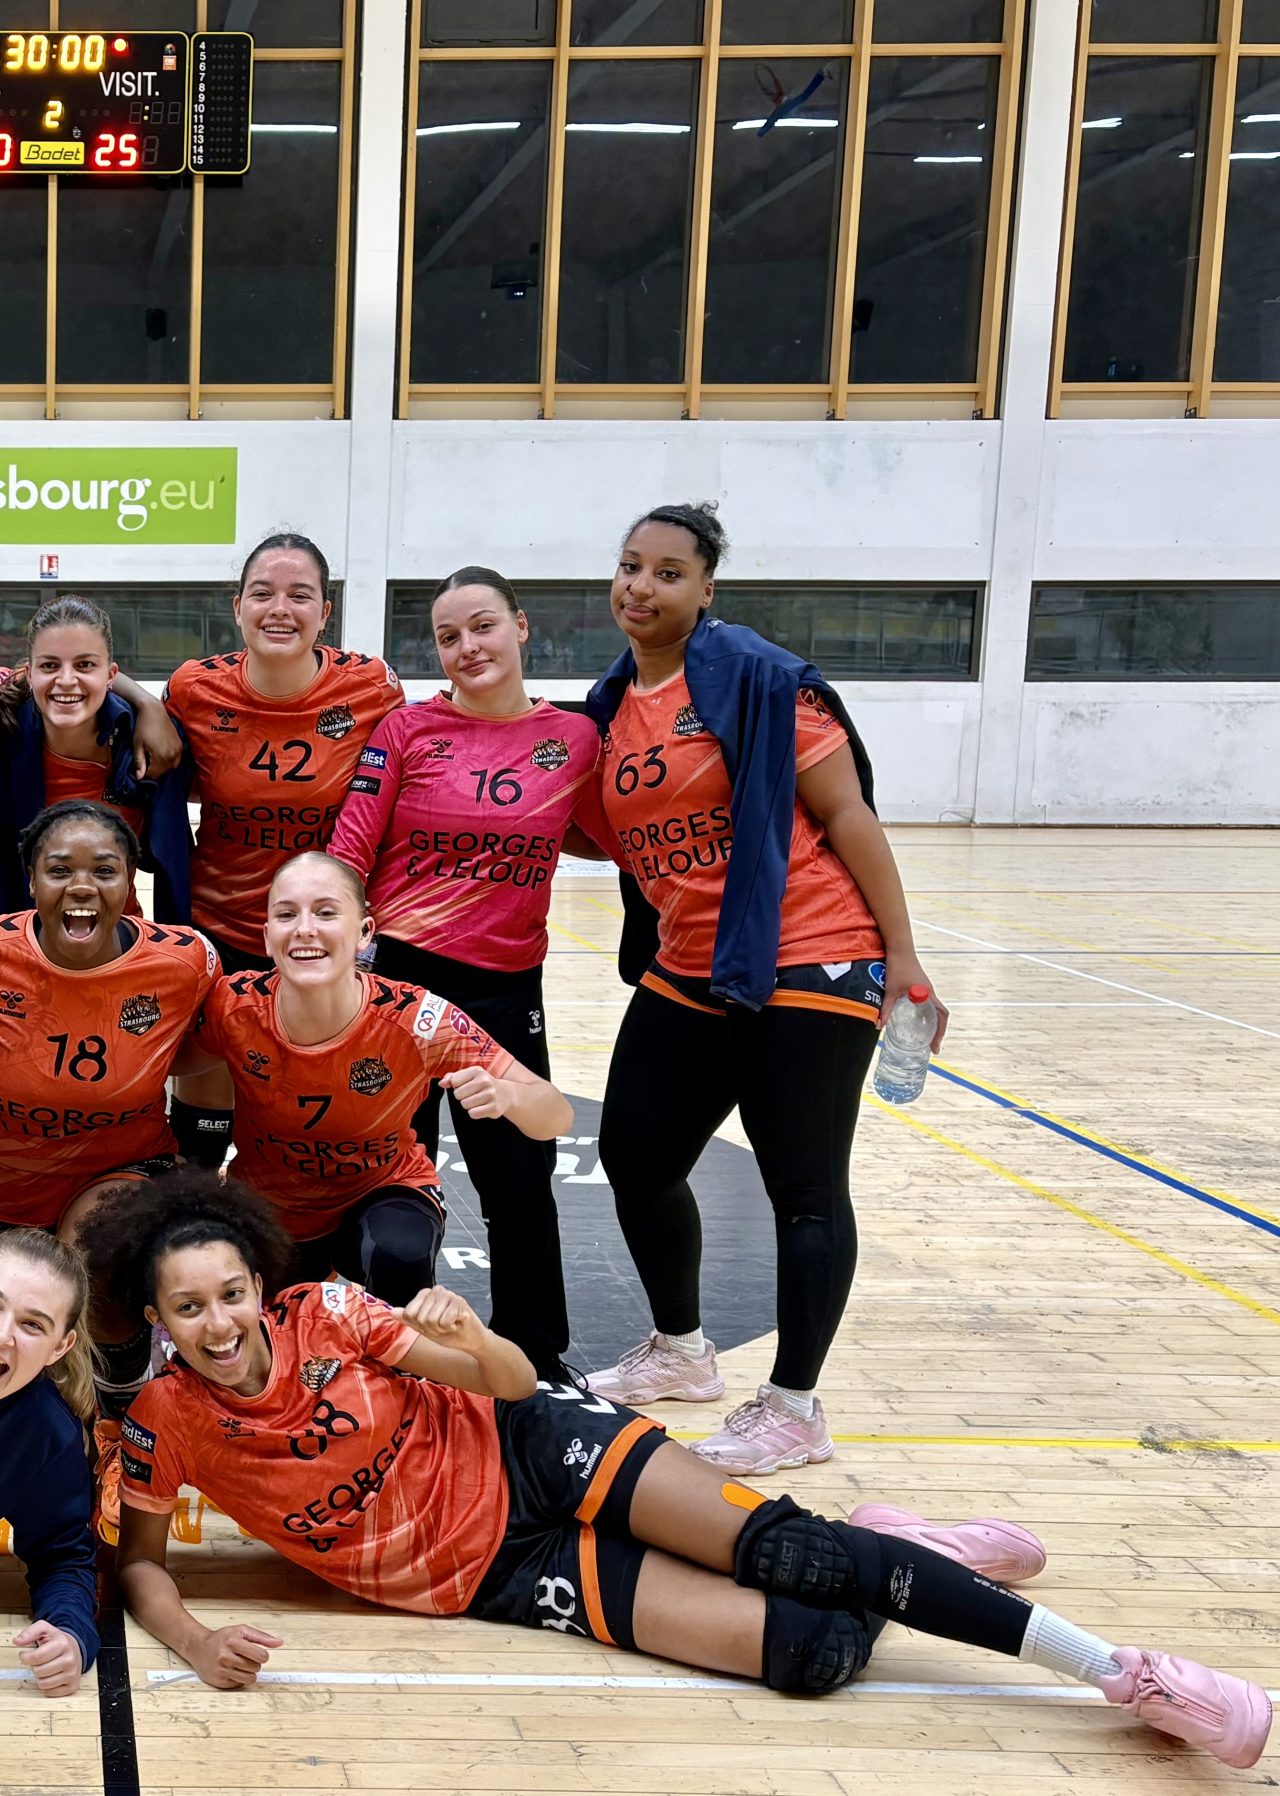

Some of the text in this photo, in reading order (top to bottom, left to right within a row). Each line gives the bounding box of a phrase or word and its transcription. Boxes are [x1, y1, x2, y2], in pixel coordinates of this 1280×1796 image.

[6, 35, 105, 70] 30:00
[199, 41, 206, 50] 4
[200, 52, 206, 60] 5
[199, 62, 206, 71] 6
[99, 71, 160, 96] VISIT.
[200, 73, 206, 81] 7
[199, 83, 206, 92] 8
[198, 93, 205, 102] 9
[45, 100, 63, 129] 2
[194, 104, 205, 113] 10
[194, 114, 203, 123] 11
[193, 125, 204, 133] 12
[193, 135, 204, 144] 13
[24, 144, 81, 161] Bodet
[95, 134, 137, 167] 25
[193, 145, 204, 154] 14
[192, 155, 204, 164] 15
[211, 723, 239, 733] hummel
[317, 719, 356, 733] STRASBOURG
[248, 739, 317, 782] 42
[531, 754, 569, 765] STRASBOURG
[616, 744, 667, 796] 63
[470, 768, 523, 806] 16
[210, 803, 338, 826] GEORGE
[619, 806, 732, 854] EORGES
[409, 829, 556, 863] GEORGES
[406, 856, 549, 890] & LELOUP
[119, 1012, 161, 1029] STRASBOURG
[46, 1032, 107, 1083] 18
[350, 1074, 392, 1088] STRASBOURG
[297, 1095, 332, 1131] 7
[198, 1119, 229, 1128] SELECT
[579, 1444, 603, 1479] hummel
